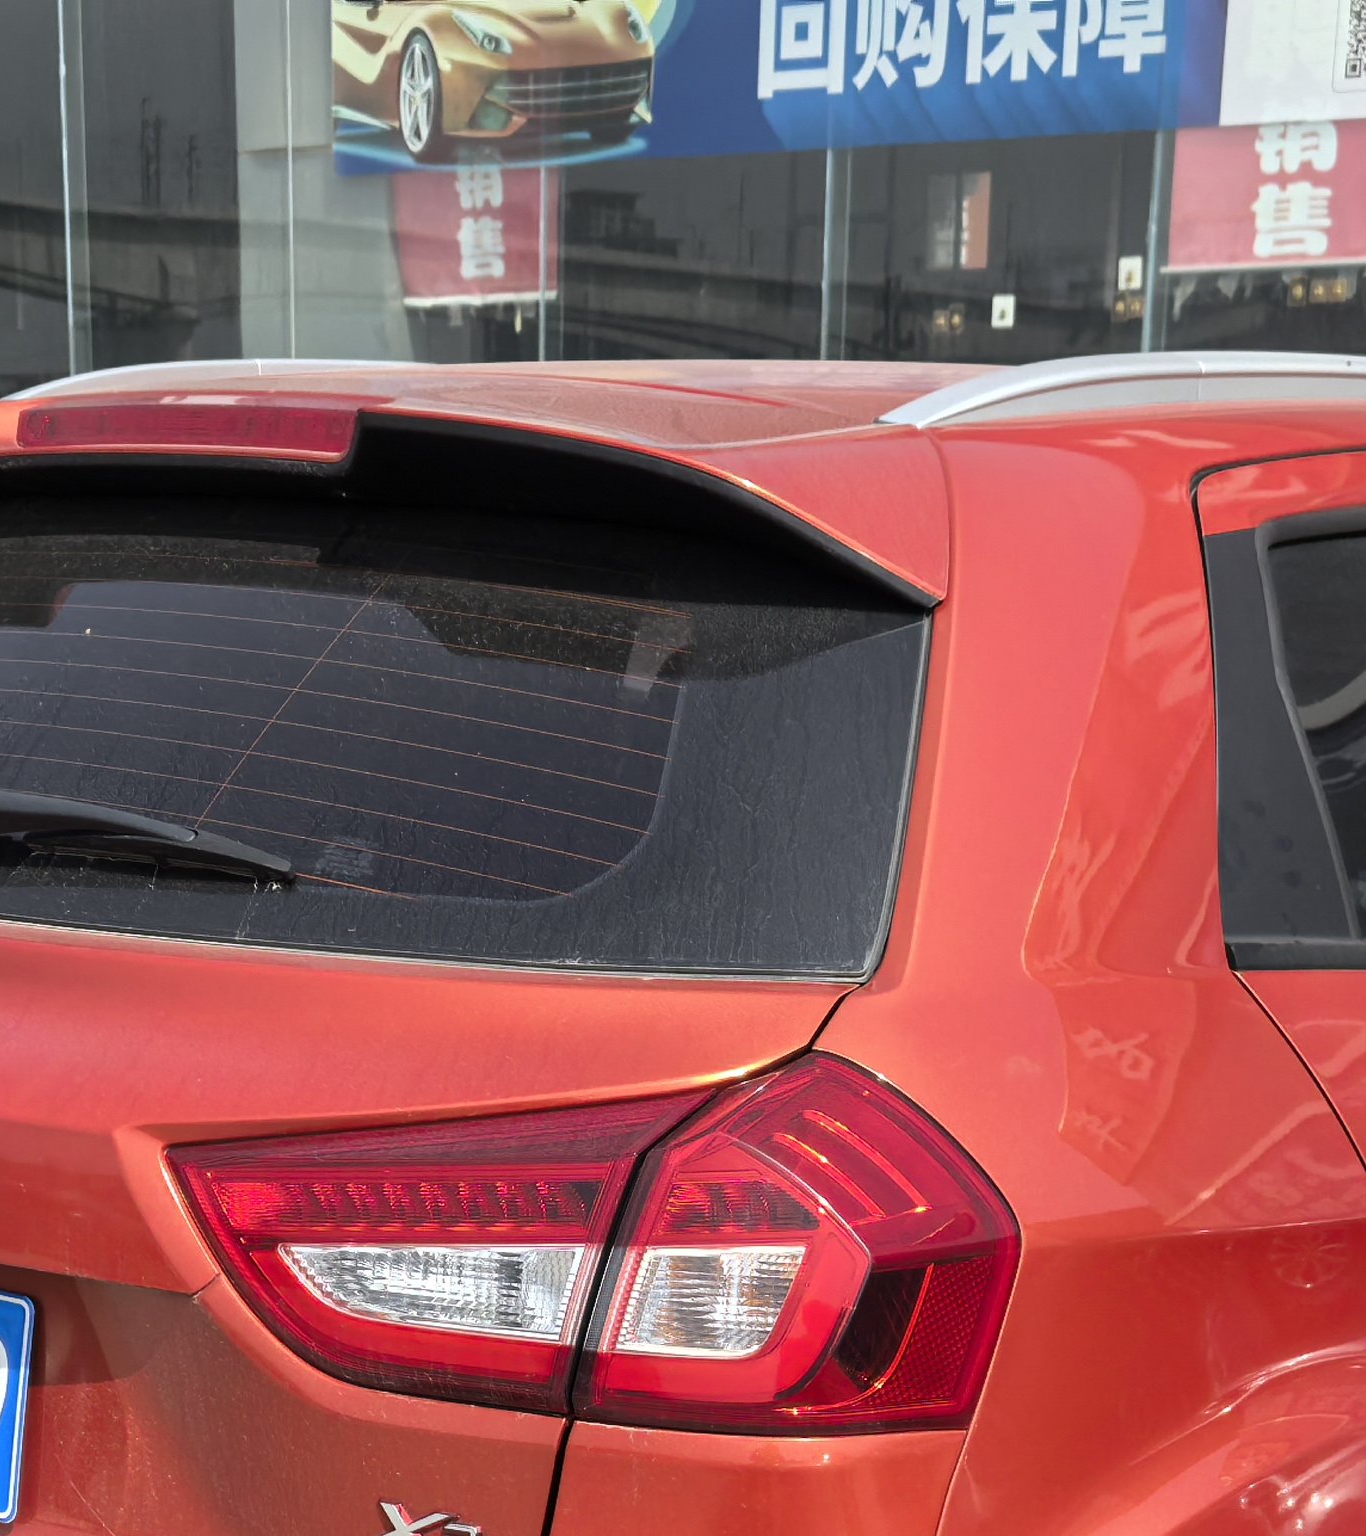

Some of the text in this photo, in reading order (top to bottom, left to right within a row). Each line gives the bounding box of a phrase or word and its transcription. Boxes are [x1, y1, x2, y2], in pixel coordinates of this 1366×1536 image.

[757, 0, 1166, 99] 回购保障
[456, 150, 505, 279] 销售
[1251, 121, 1337, 257] 销售
